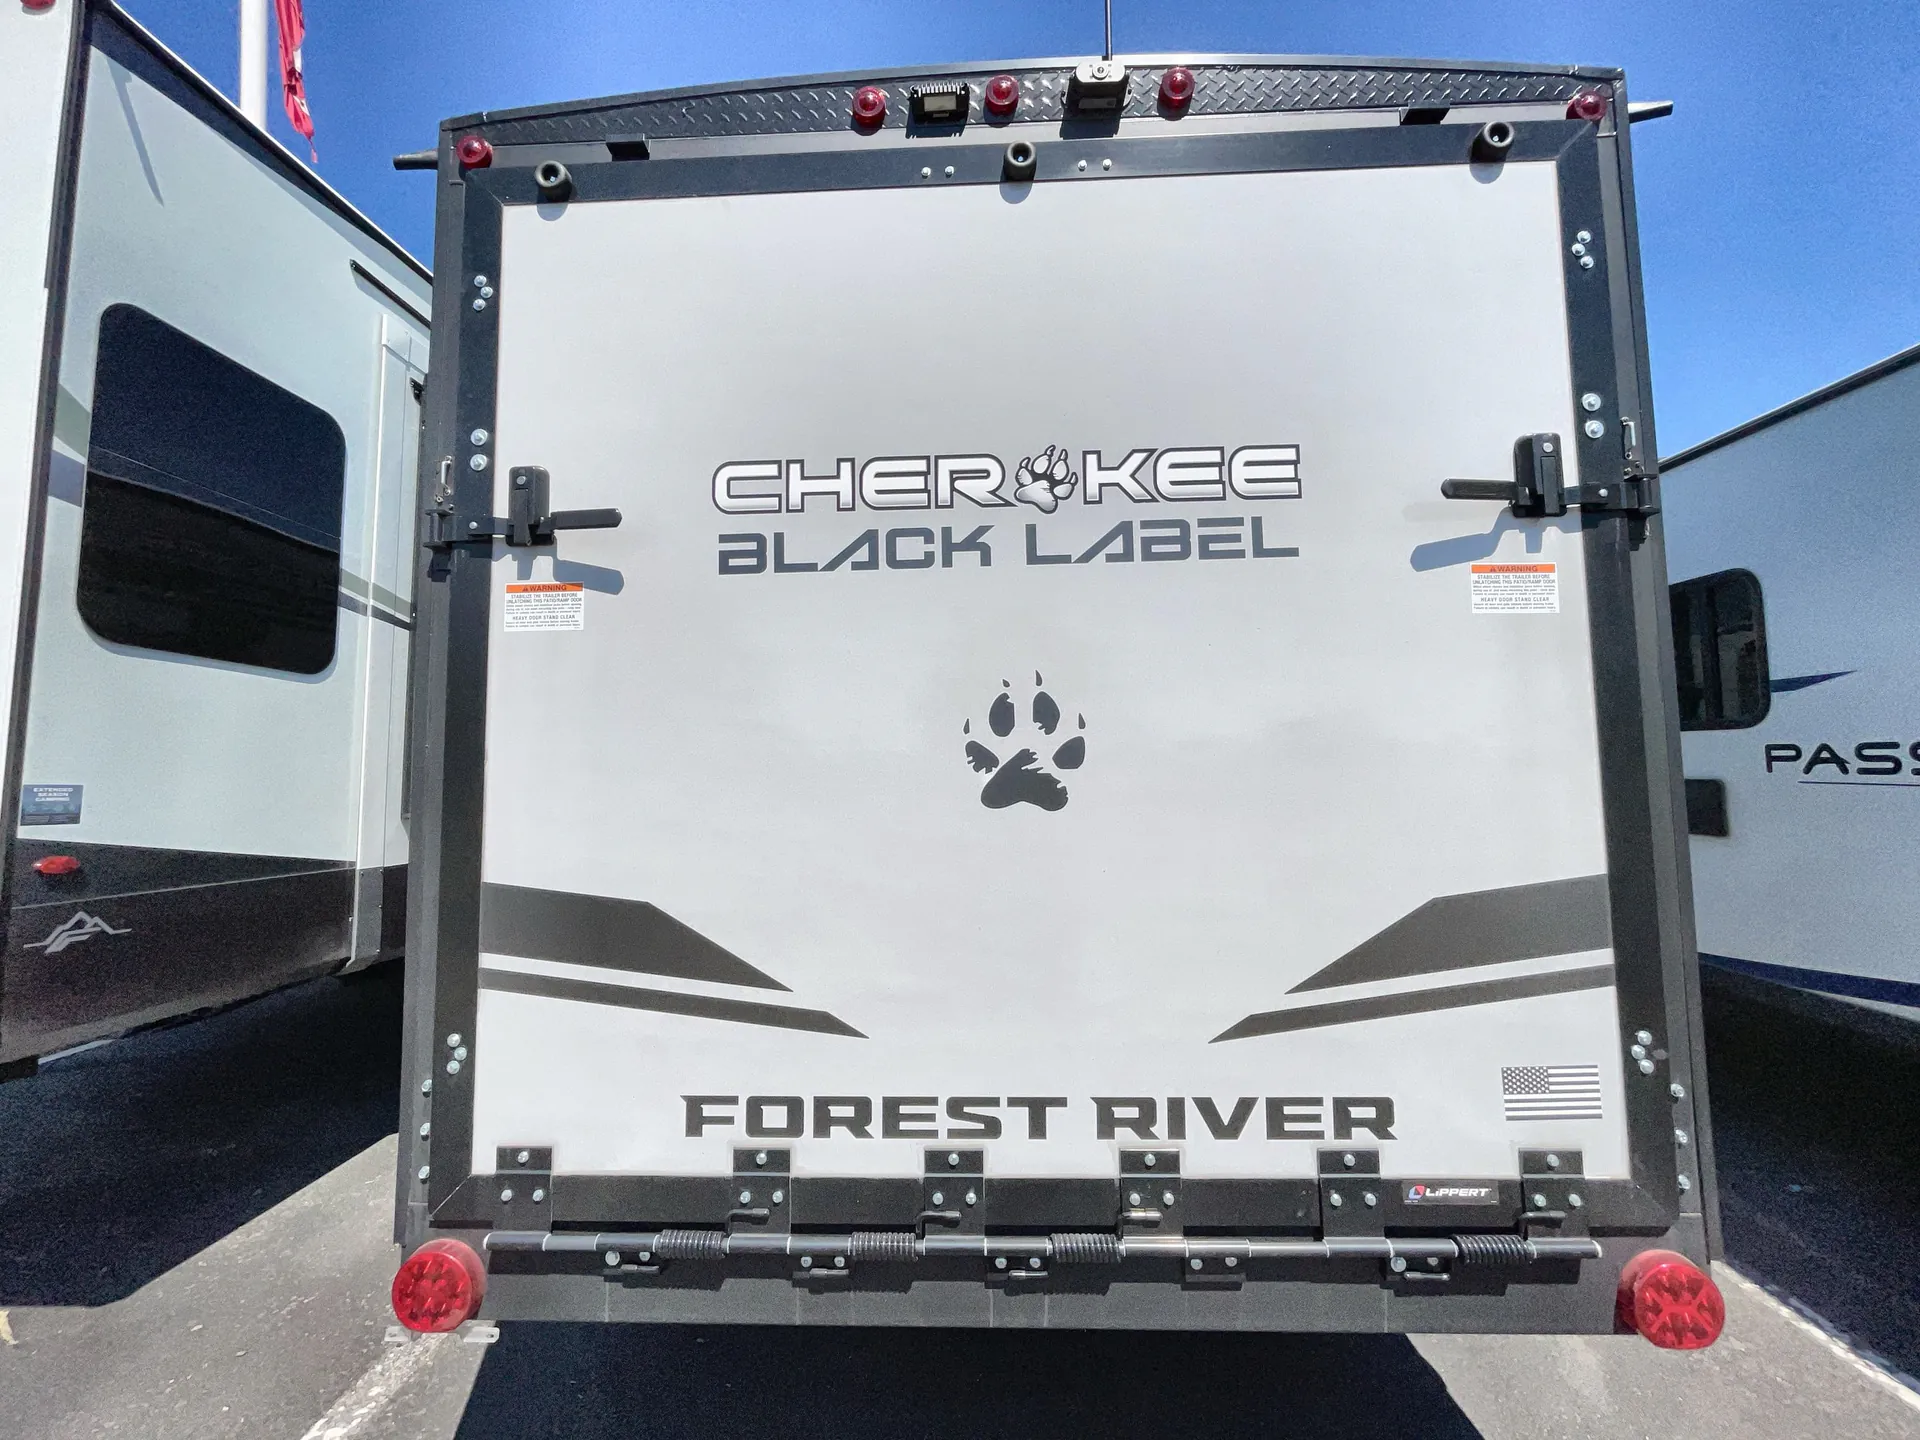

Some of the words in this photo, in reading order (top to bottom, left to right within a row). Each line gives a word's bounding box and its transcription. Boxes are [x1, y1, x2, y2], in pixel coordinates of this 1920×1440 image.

[711, 443, 1302, 515] CHERKEE
[718, 525, 995, 576] BLACK
[1025, 516, 1300, 567] LABEL
[530, 584, 567, 592] WARNING
[1765, 741, 1920, 776] PAS
[679, 1094, 1068, 1141] FOREST
[1089, 1095, 1399, 1142] RIVER
